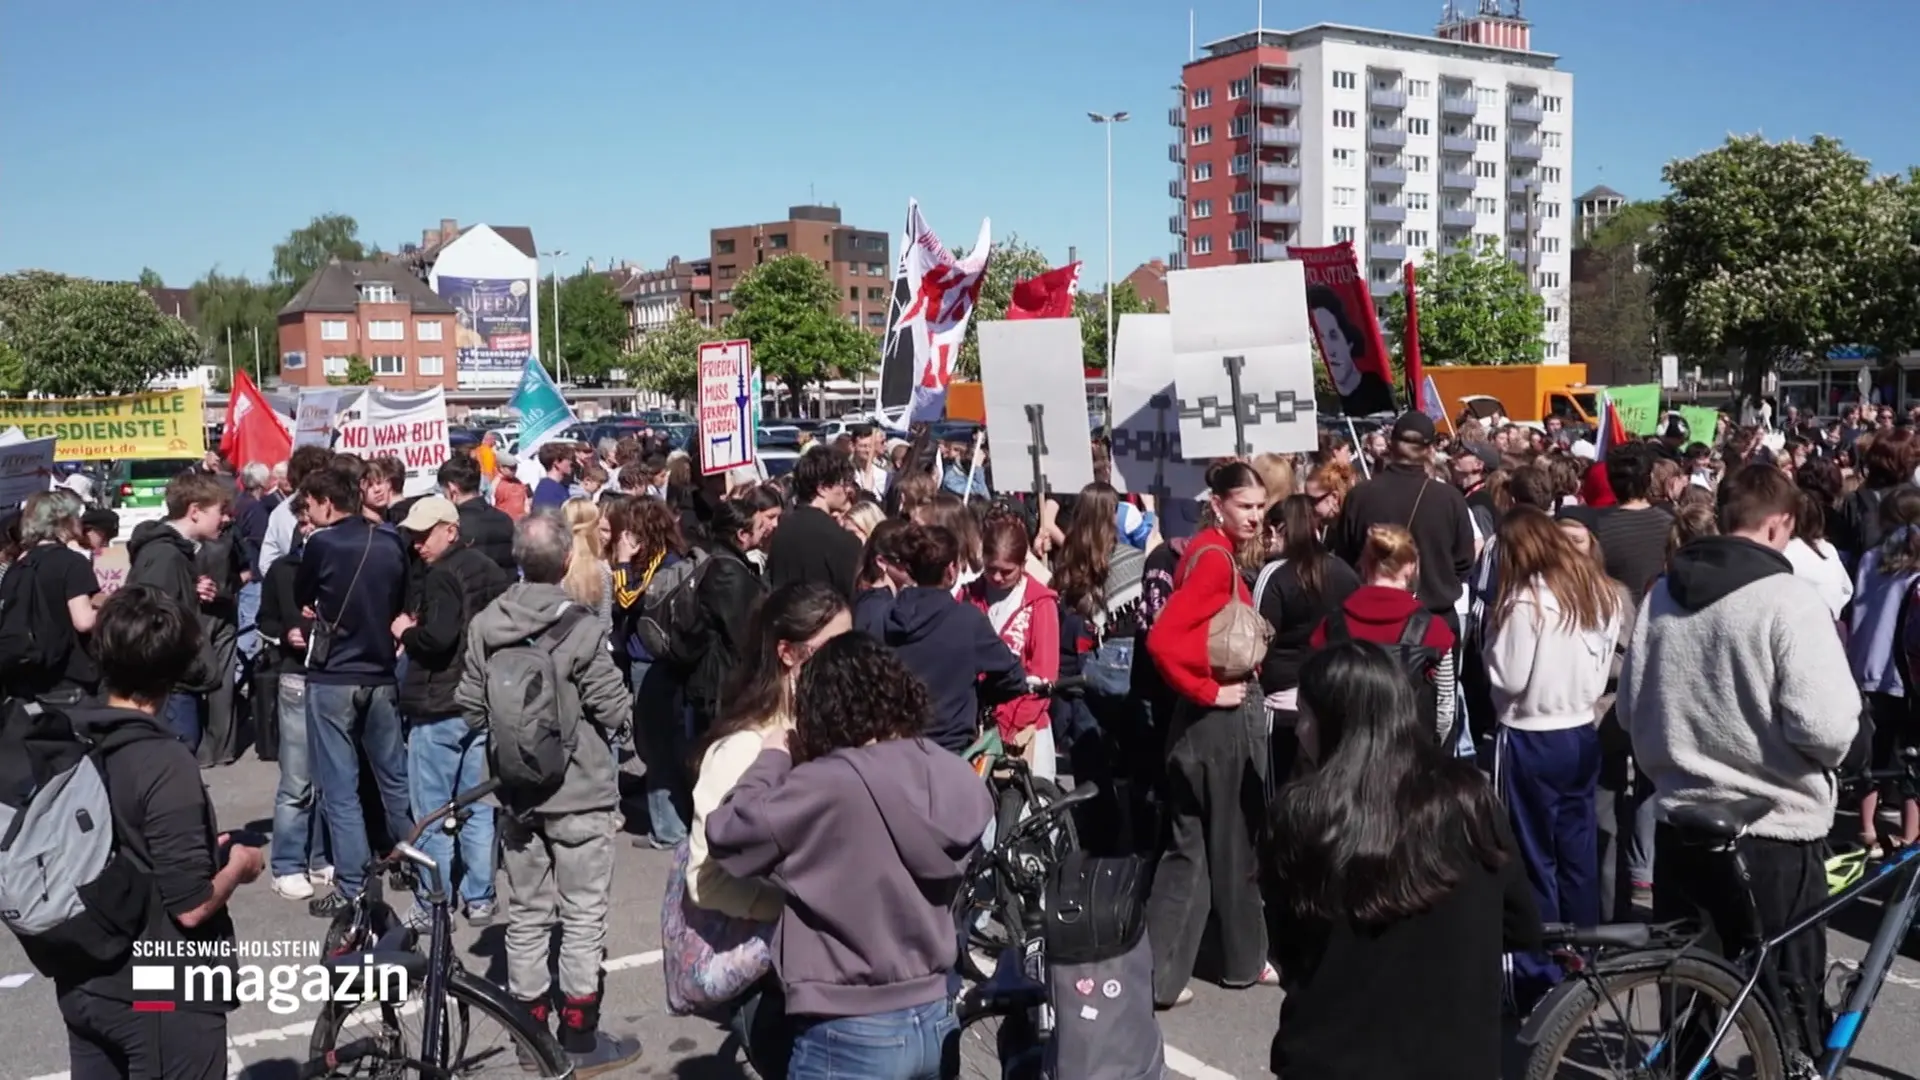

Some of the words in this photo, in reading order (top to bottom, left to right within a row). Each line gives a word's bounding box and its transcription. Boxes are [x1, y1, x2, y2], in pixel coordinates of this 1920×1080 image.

[448, 295, 520, 312] QUEEN
[703, 359, 738, 377] FRIEDEN
[705, 383, 728, 402] MUSS
[132, 395, 185, 415] ALLE
[343, 426, 368, 448] NO
[373, 422, 407, 446] WAR
[412, 419, 445, 443] BUT
[706, 420, 738, 433] WERDEN
[405, 443, 446, 468] WAR
